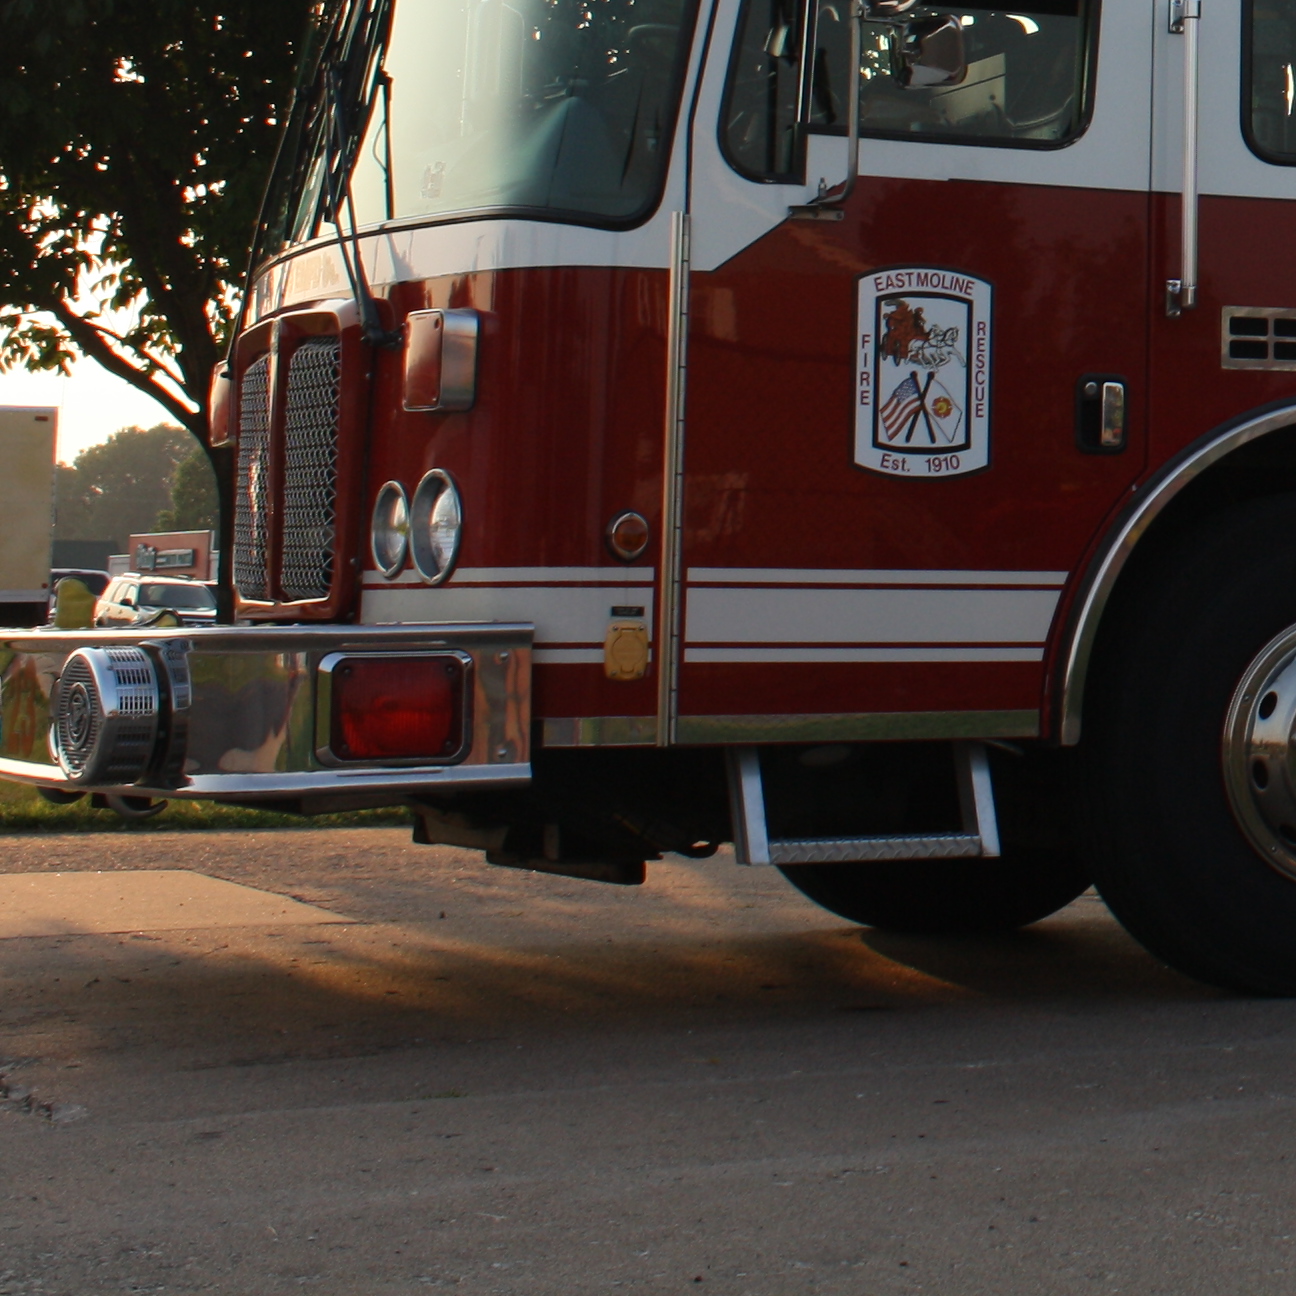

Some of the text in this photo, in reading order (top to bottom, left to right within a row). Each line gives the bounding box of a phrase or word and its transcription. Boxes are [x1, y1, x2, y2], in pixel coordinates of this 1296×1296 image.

[860, 334, 871, 406] FIRE
[975, 321, 987, 419] RESCUE
[880, 453, 961, 473] Est. 1910
